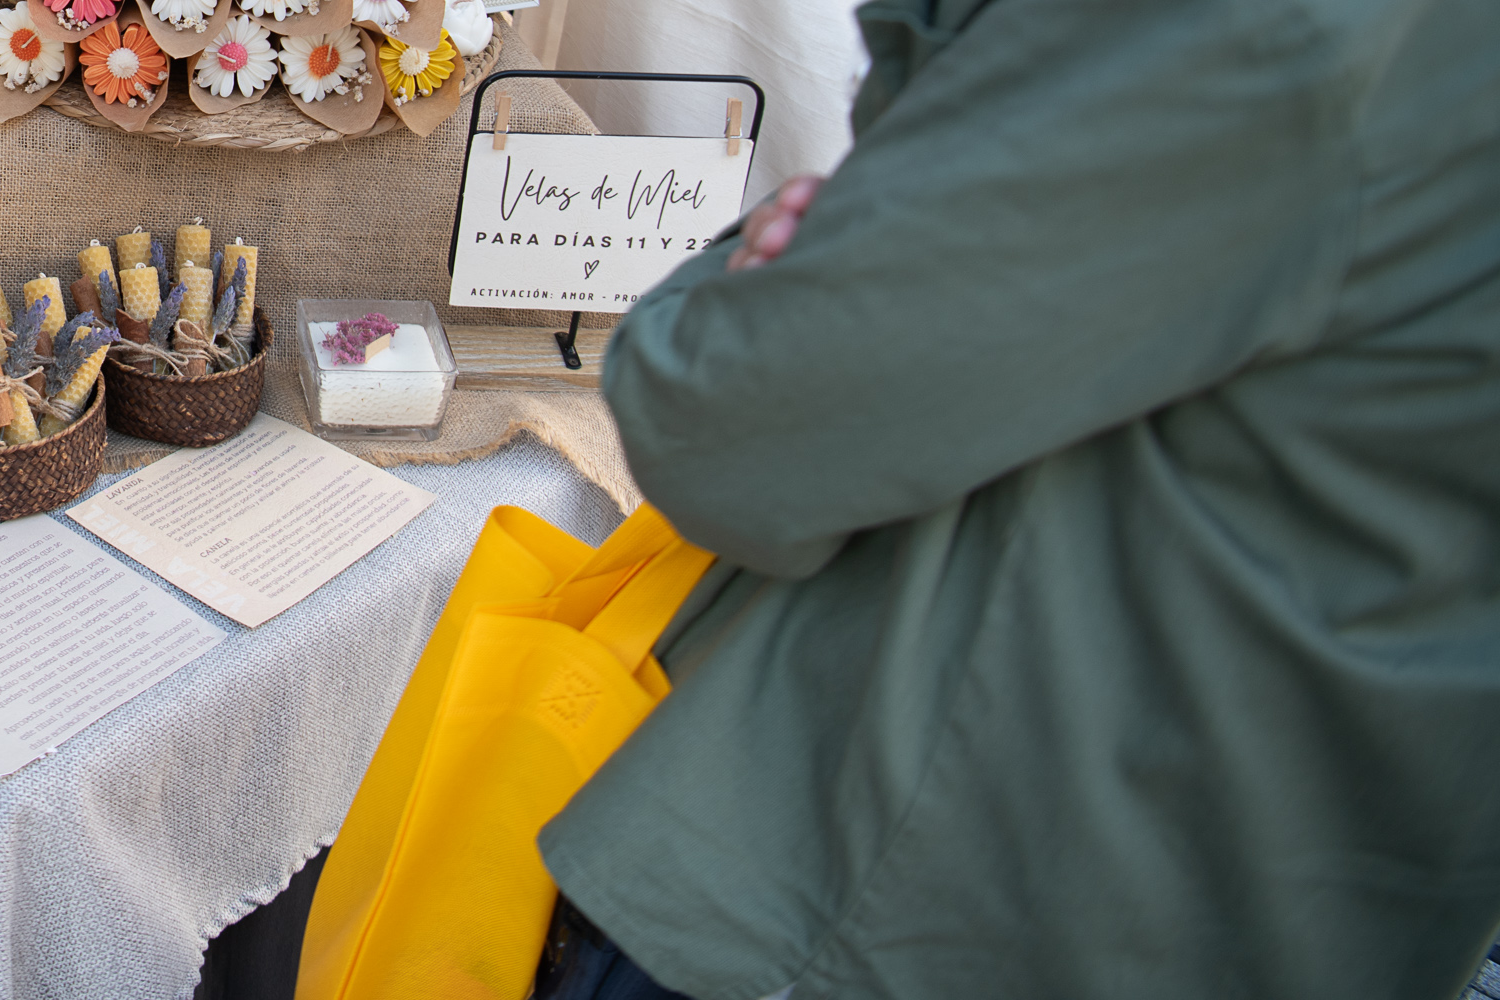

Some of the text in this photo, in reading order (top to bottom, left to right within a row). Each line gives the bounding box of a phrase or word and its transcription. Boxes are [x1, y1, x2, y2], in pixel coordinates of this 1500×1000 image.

[501, 156, 707, 230] Velas de Miel
[475, 231, 540, 246] PARA
[554, 231, 613, 248] DÍAS
[626, 237, 647, 250] 11
[660, 237, 673, 250] Y
[470, 287, 554, 300] ACTIVACIÓN:
[561, 292, 595, 302] AMOR
[106, 478, 144, 500] LAVANDA
[0, 548, 30, 565] cuentan
[29, 540, 44, 549] con
[200, 538, 232, 558] CANELA
[9, 555, 40, 574] maestros
[39, 546, 55, 556] que
[24, 557, 59, 579] presentan
[58, 548, 74, 558] una
[11, 583, 38, 600] mundo
